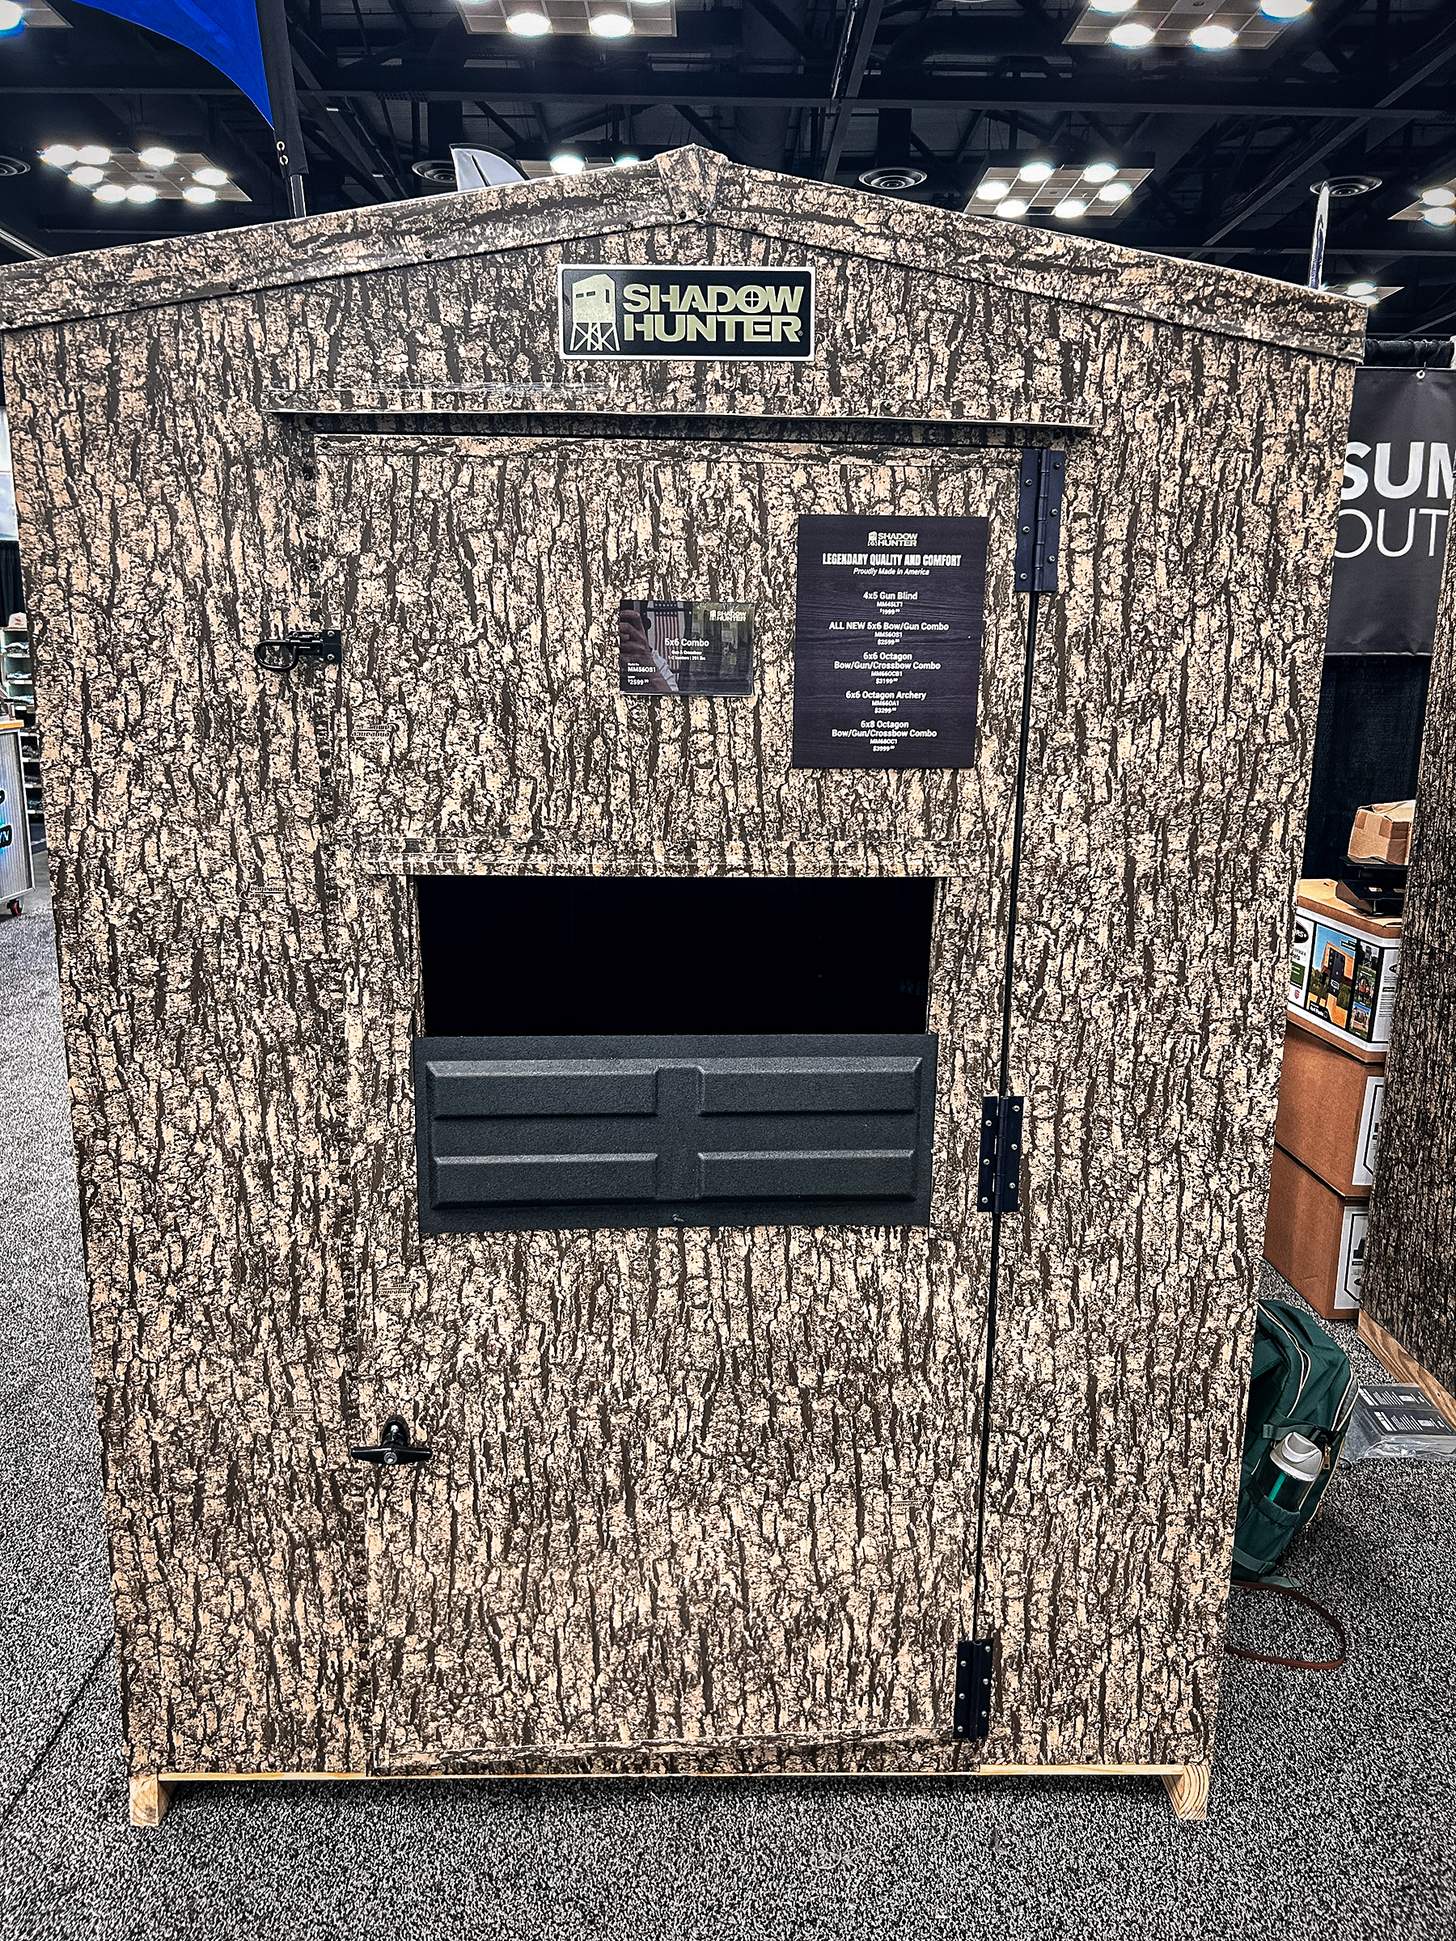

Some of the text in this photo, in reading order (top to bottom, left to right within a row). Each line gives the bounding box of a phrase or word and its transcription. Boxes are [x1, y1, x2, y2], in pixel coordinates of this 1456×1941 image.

[622, 283, 804, 314] SHADOW
[623, 314, 803, 343] HUNTER
[877, 532, 918, 540] SHADOW
[822, 553, 962, 567] LEGENDARY QUALITY AND COMFORT
[853, 568, 877, 576] Proudly
[863, 592, 918, 600] 4x5 Gun Blind
[829, 622, 949, 631] ALL NEW 5x6 Bow/Gun Combo
[681, 638, 710, 647] Combo
[863, 652, 912, 662] 6x6 Octagon
[834, 661, 912, 669] Bow/Gun/Crossbow
[846, 691, 927, 701] 6x6 Octagon Archery
[861, 720, 909, 730] 6x8 Octagon
[832, 729, 908, 737] Bow/Gun/Crossbow
